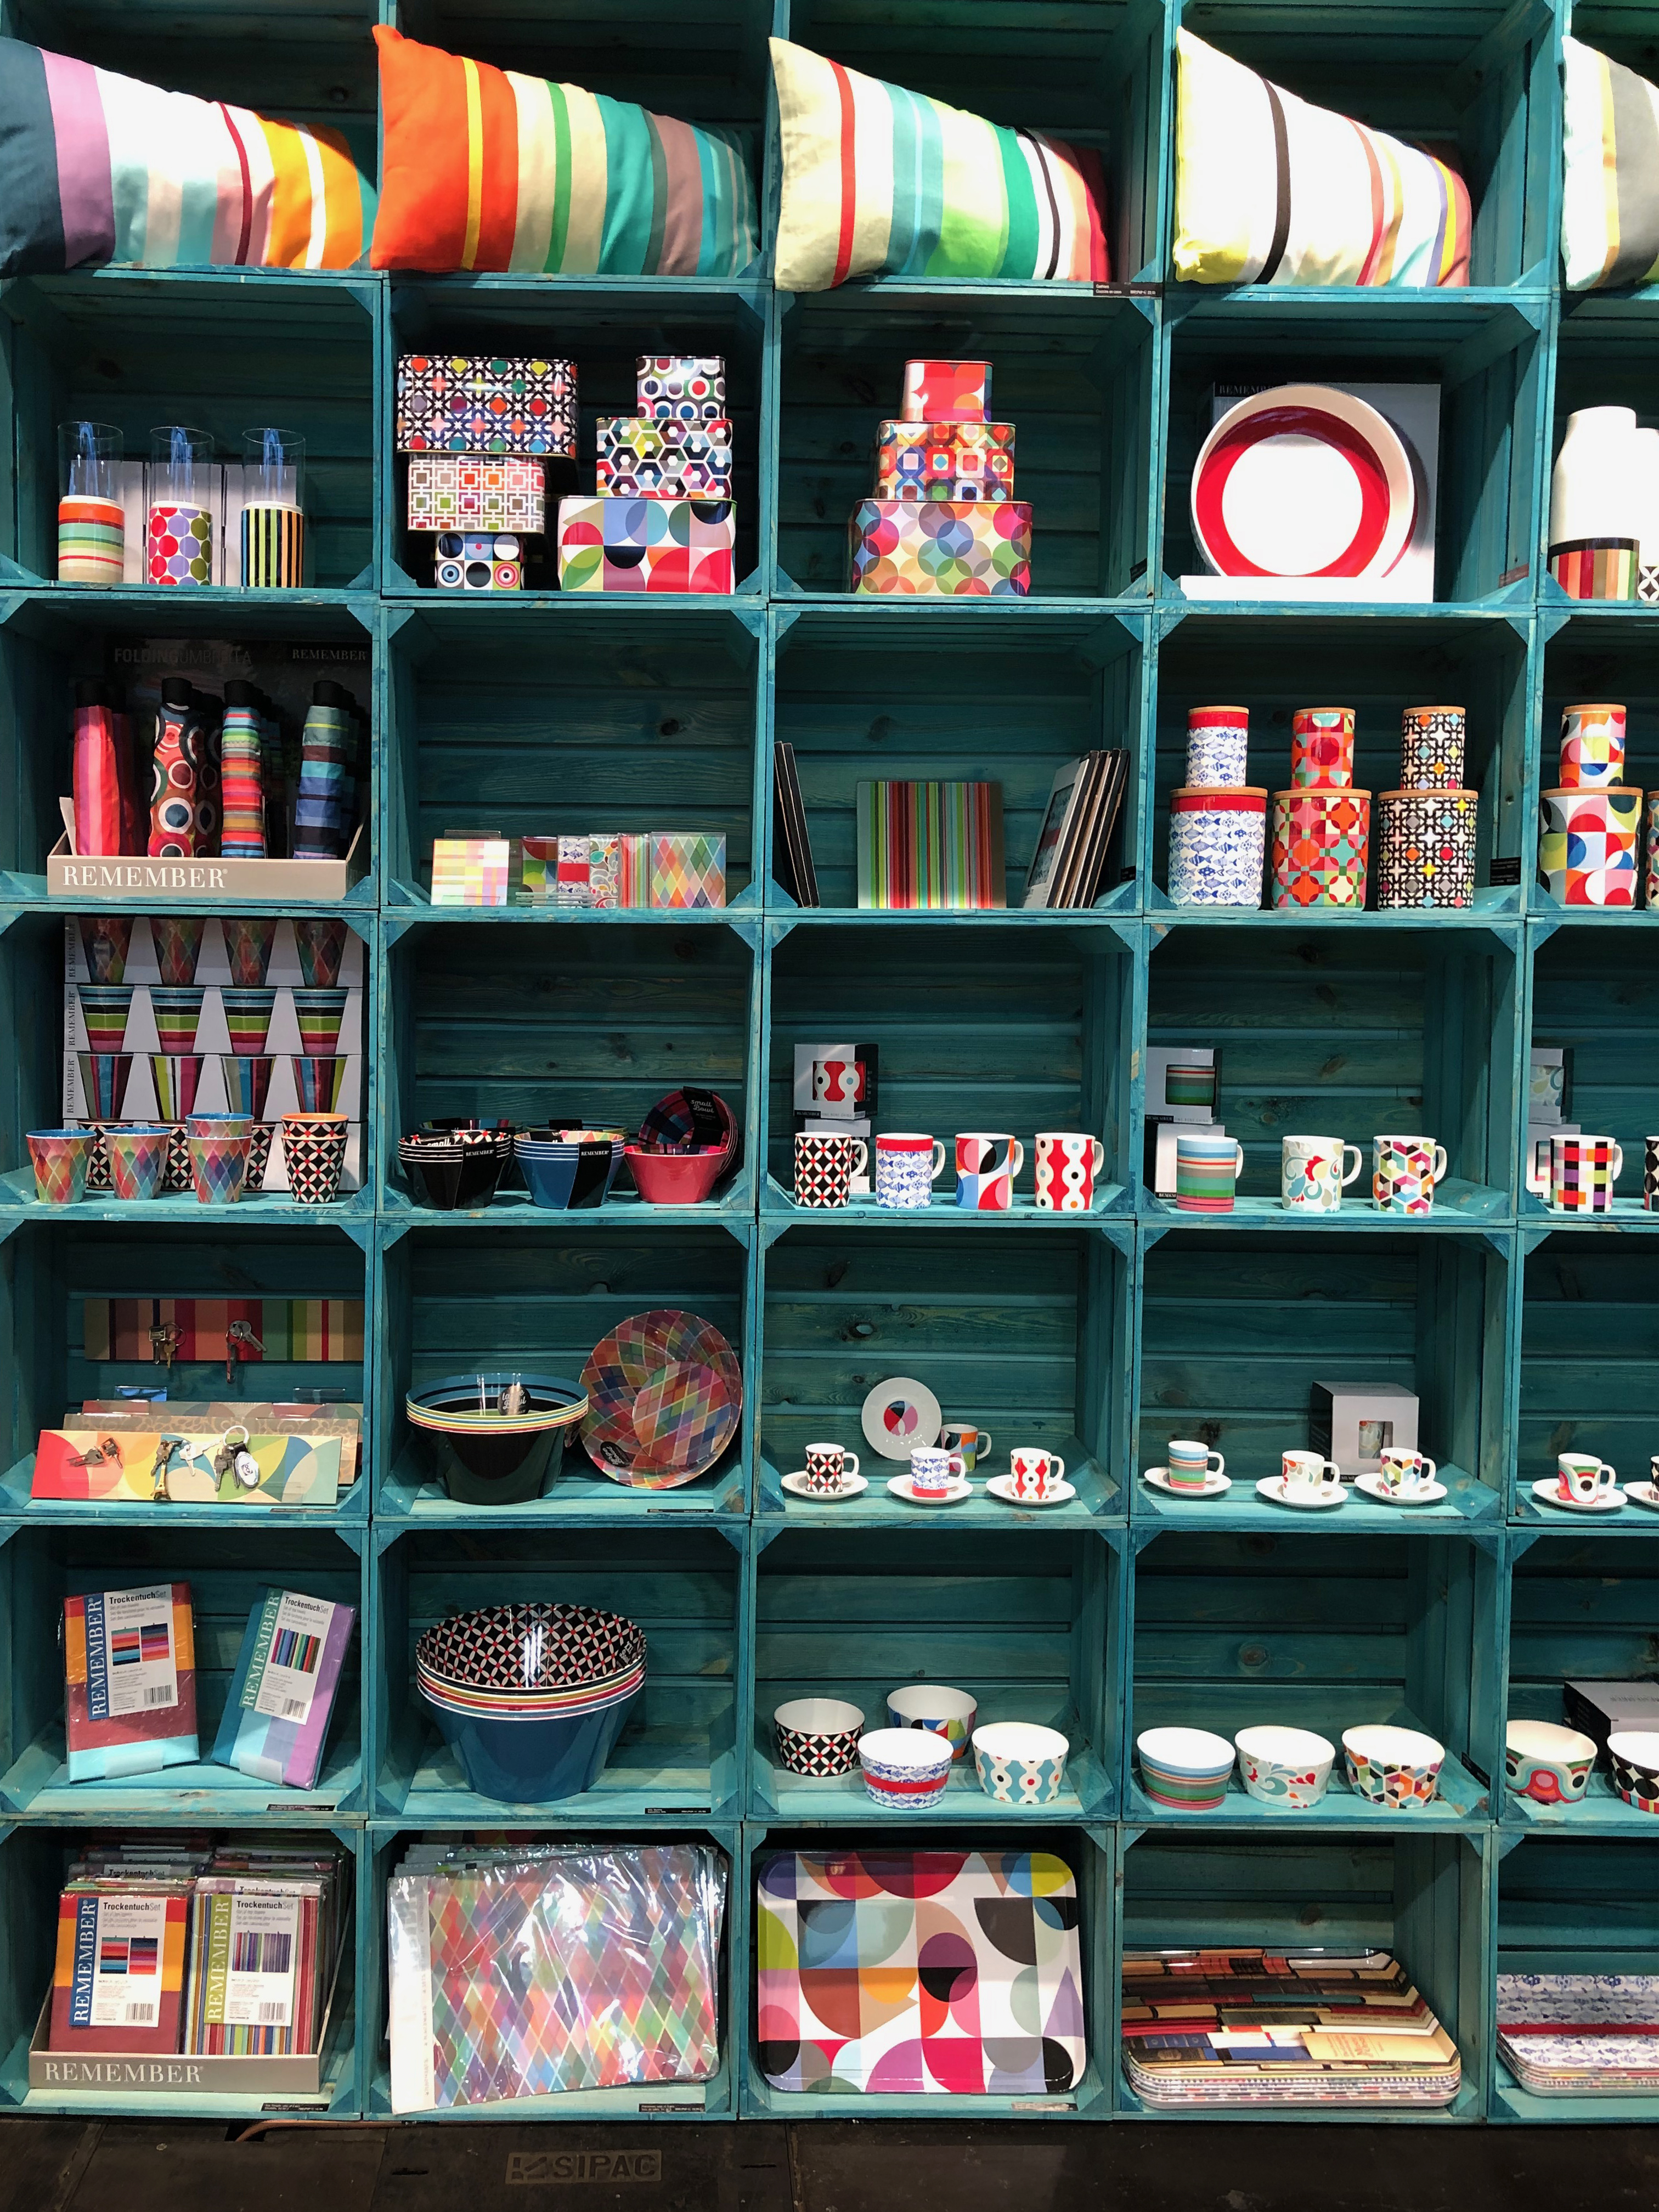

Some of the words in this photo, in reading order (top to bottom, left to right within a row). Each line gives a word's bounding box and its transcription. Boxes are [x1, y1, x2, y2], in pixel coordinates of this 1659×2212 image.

[292, 649, 366, 661] REMEMBER
[693, 1104, 714, 1113] Bowl
[109, 1590, 167, 1605] TrockentuchSet
[285, 1596, 329, 1615] TrockentuchSet
[103, 1901, 161, 1911] TrockentuchSet
[236, 1900, 294, 1910] TrockentuchSet
[553, 2154, 656, 2179] SIPAC
